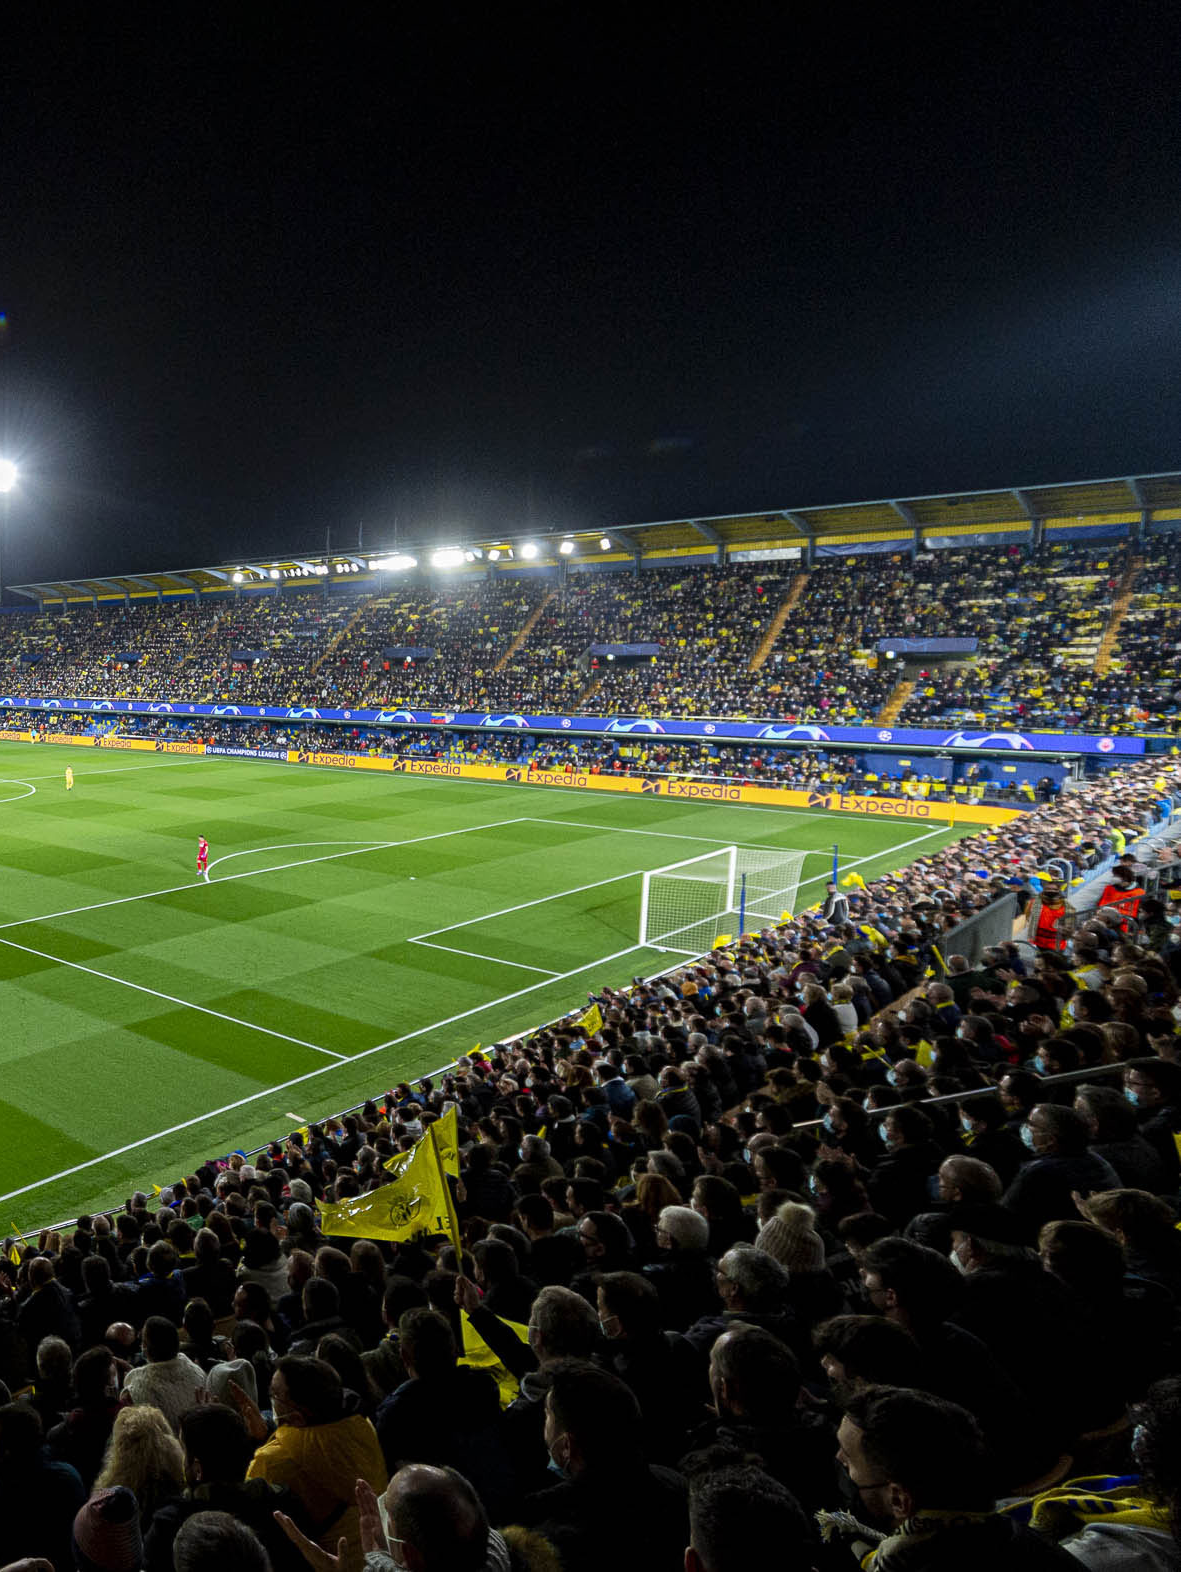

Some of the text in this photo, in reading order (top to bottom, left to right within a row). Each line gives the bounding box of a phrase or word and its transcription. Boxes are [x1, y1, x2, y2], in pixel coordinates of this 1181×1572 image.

[48, 734, 73, 744] Expedia
[103, 738, 132, 748] Expedia
[166, 743, 199, 754] Expedia
[226, 748, 258, 757] CHAMPIONS
[258, 750, 280, 759] LEAGUE
[313, 751, 356, 767] Expedia
[410, 760, 461, 776] Expedia
[526, 770, 588, 787] Expedia
[667, 781, 741, 800] Expedia
[840, 795, 930, 817] Expedia
